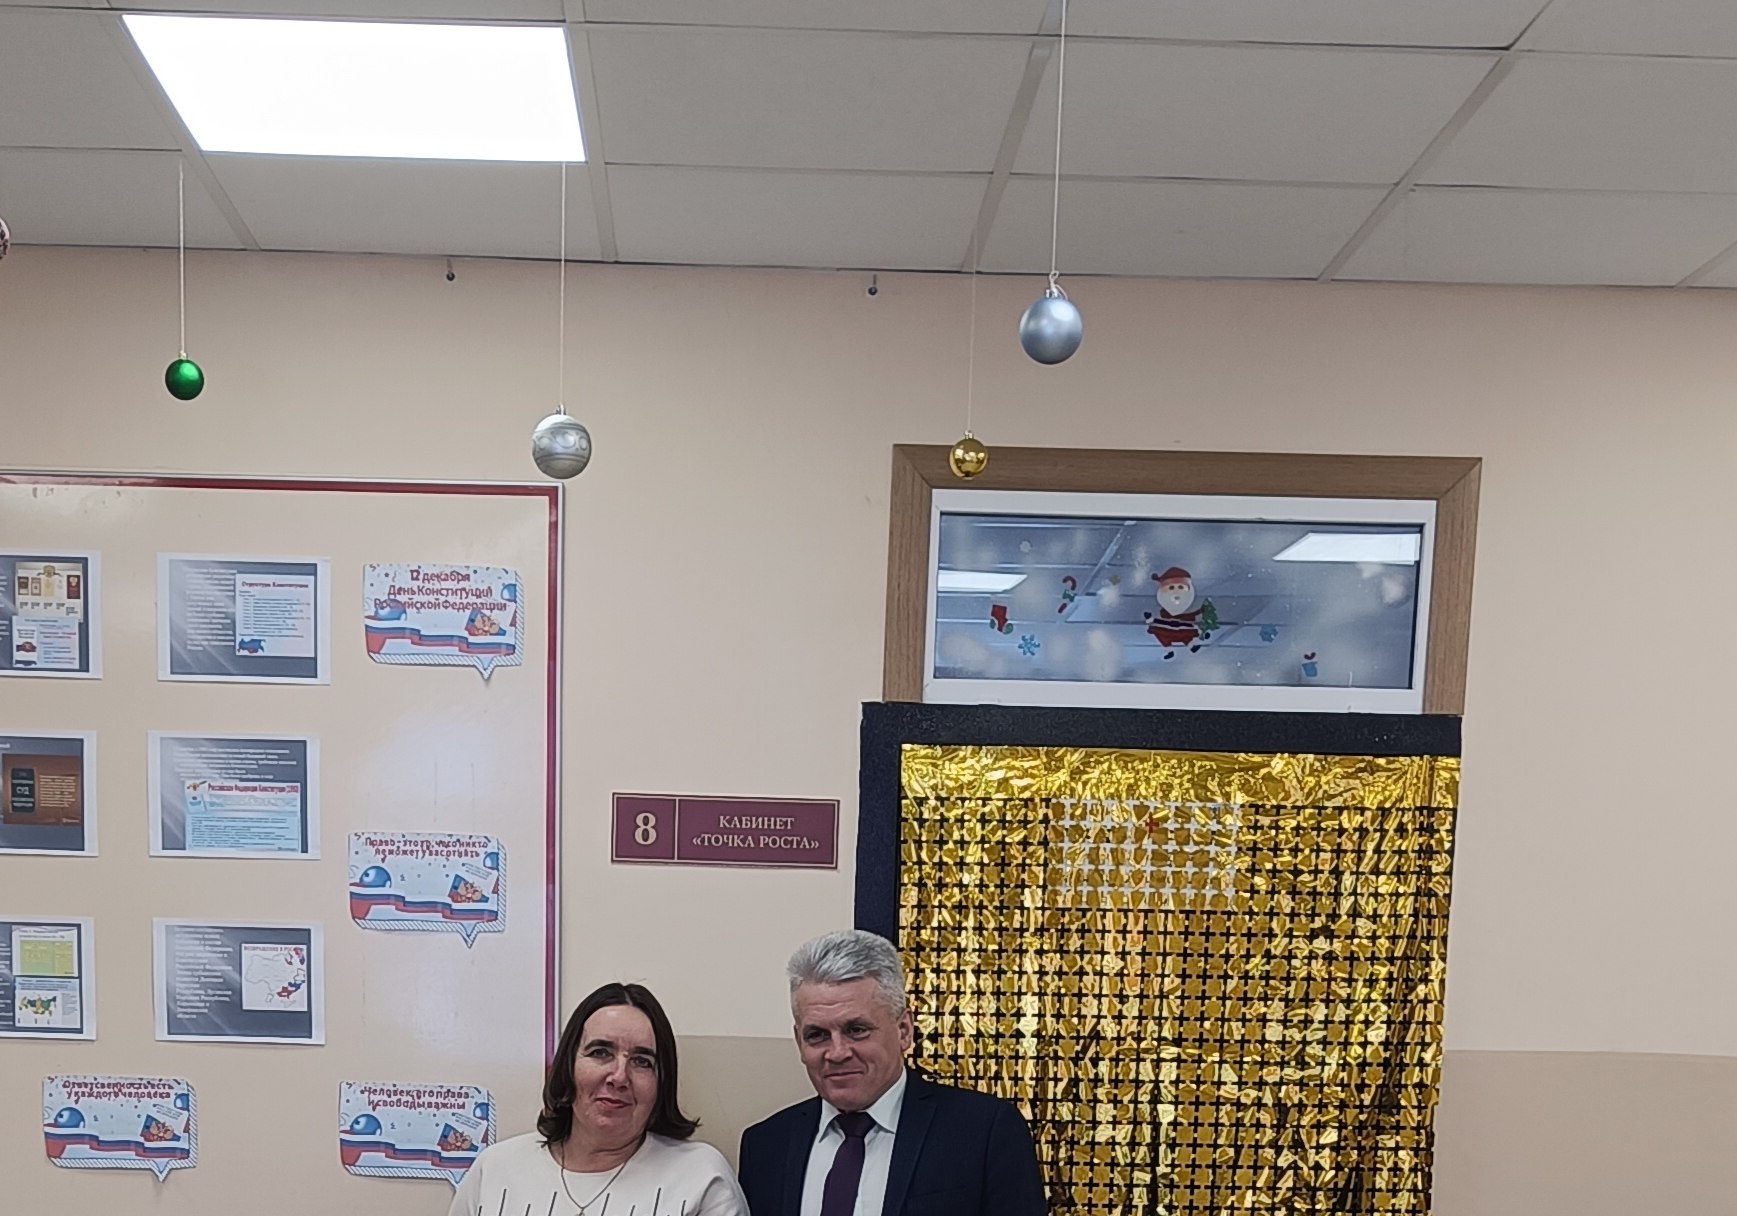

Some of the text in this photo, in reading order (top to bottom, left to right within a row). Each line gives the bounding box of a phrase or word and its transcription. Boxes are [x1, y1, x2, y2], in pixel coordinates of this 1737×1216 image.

[410, 570, 471, 584] 12 декабря
[388, 585, 417, 598] День
[442, 599, 507, 612] Федерации
[634, 812, 657, 845] 8
[719, 815, 795, 830] КАБИНЕТ
[365, 837, 396, 847] Право
[458, 840, 488, 849] никто
[692, 833, 820, 849] «ТОЧКА РОСТА»
[387, 849, 420, 857] может
[428, 849, 445, 858] вас
[73, 1090, 120, 1100] каждого
[120, 1090, 171, 1100] человека
[436, 1089, 470, 1100] права
[427, 1100, 466, 1110] важны
